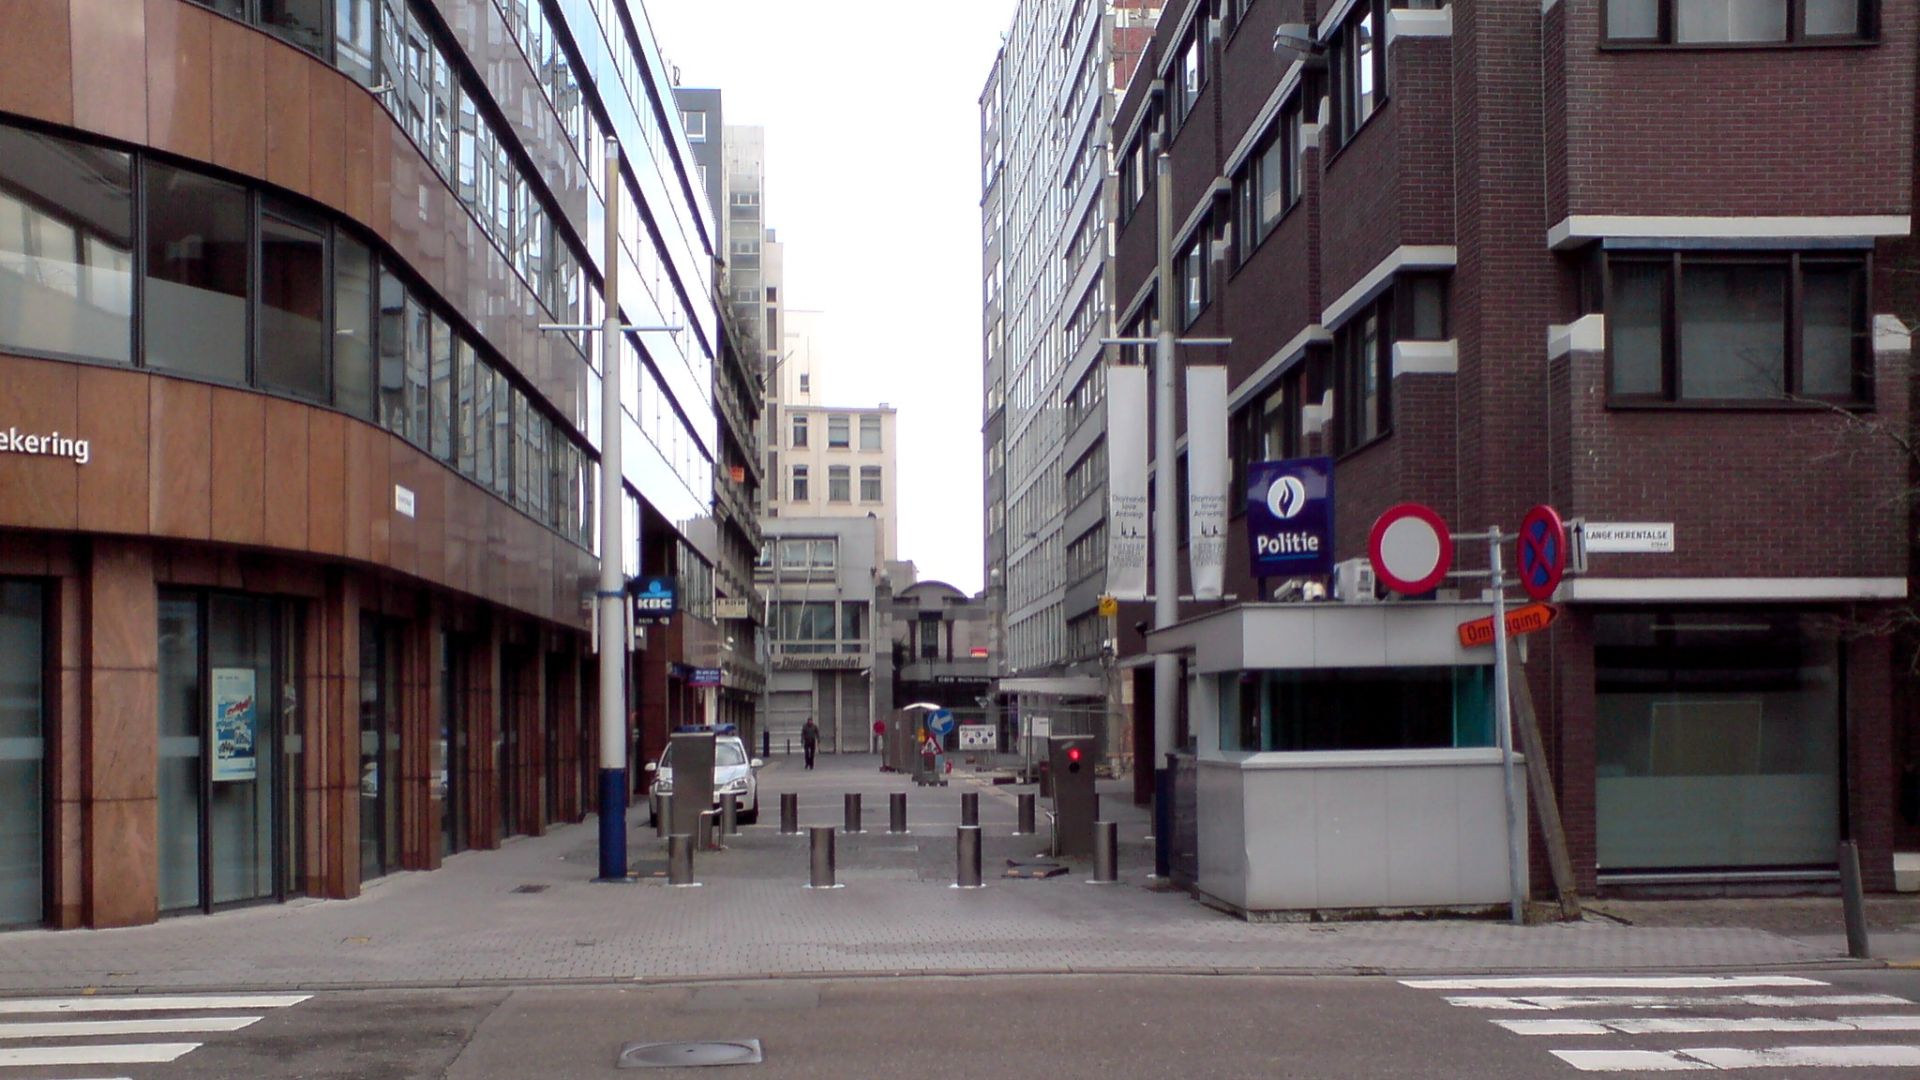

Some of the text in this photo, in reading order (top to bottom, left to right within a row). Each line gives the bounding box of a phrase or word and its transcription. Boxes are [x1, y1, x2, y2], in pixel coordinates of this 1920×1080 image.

[1586, 530, 1667, 540] LANGE HERENTALSE
[1257, 531, 1319, 555] Politie
[638, 598, 672, 610] KBC
